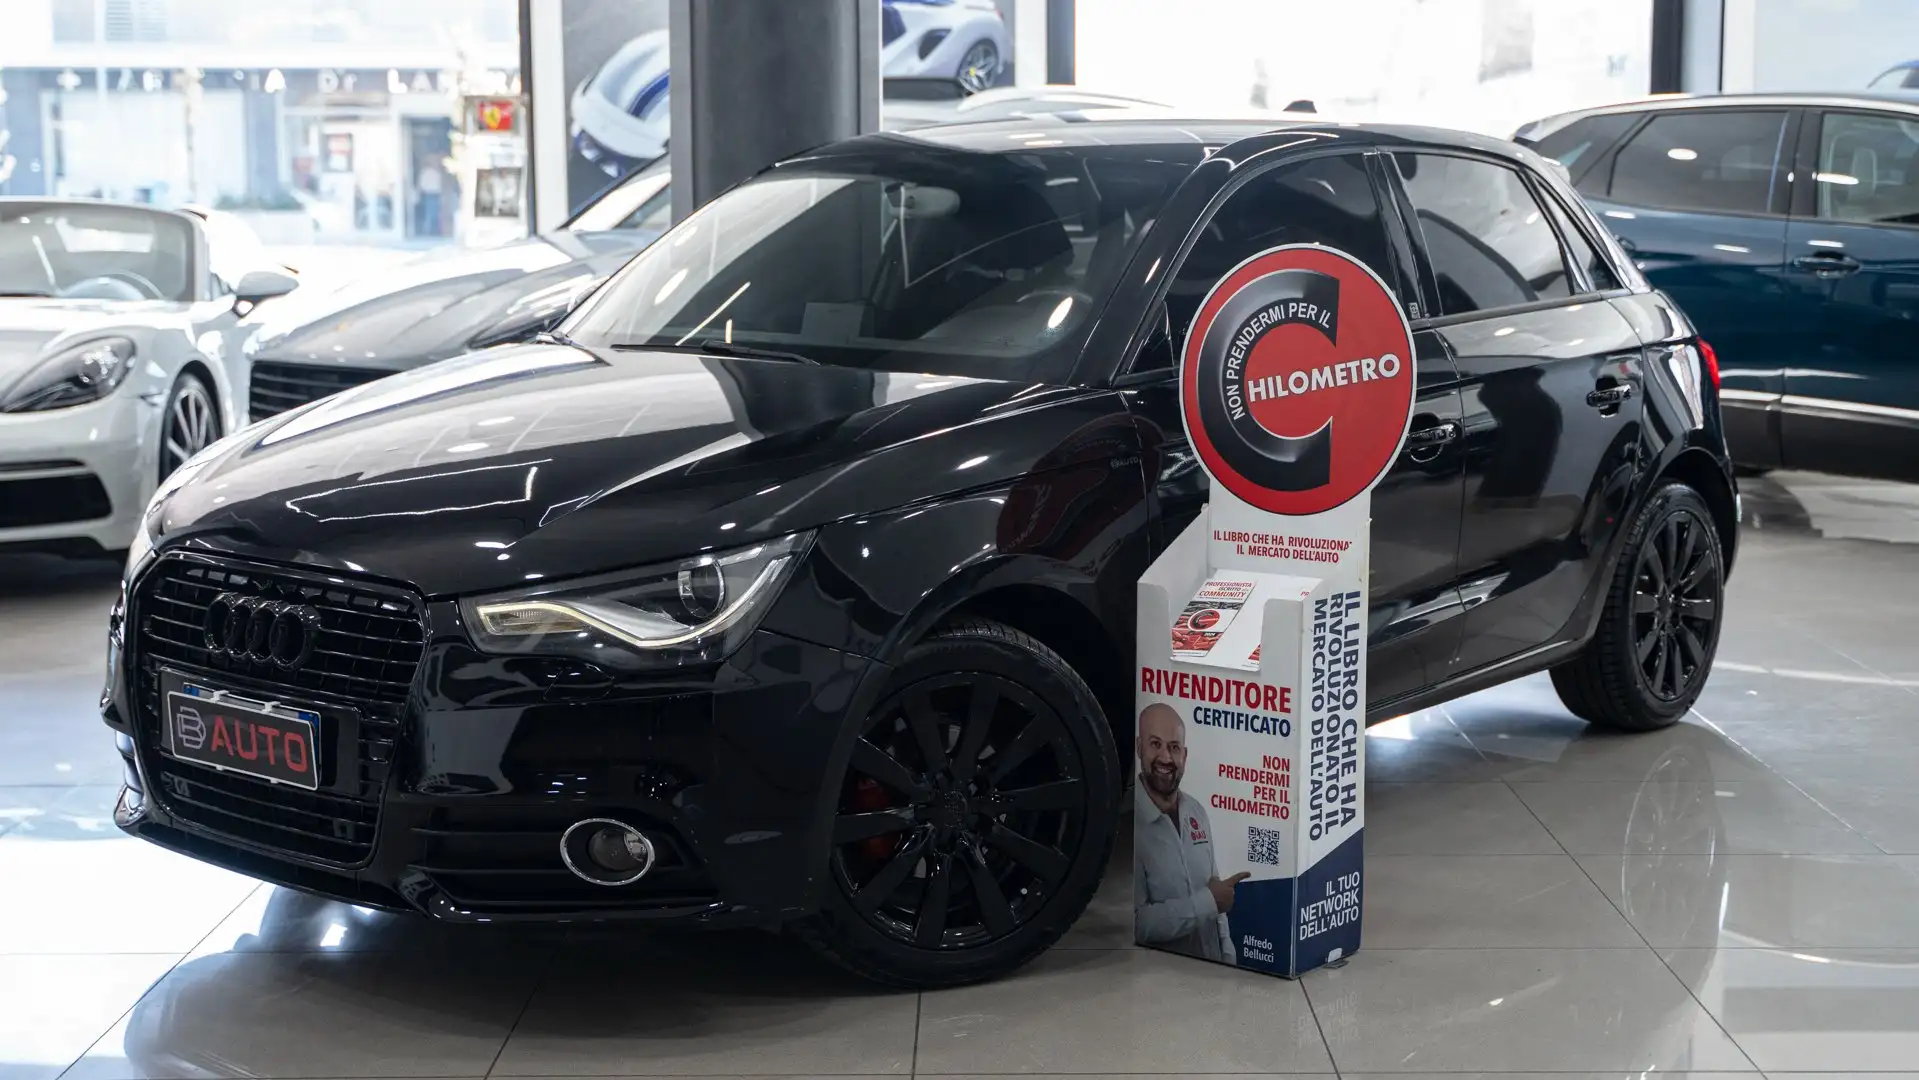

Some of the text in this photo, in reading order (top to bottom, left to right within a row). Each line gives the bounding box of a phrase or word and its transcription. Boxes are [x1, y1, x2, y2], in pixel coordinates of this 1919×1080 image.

[1226, 302, 1332, 420] NON PRENDERMI PER IL
[1214, 530, 1222, 540] IL
[1224, 530, 1250, 543] LIBRO
[1252, 533, 1270, 545] CHE
[1272, 535, 1284, 546] HA
[1236, 544, 1339, 563] IL MERCATO DELL'AUTO
[1141, 667, 1291, 714] RIVENDITORE
[1193, 706, 1291, 738] CERTIFICATO
[1310, 598, 1328, 841] MERCATO DELL'AUTO
[1325, 592, 1343, 835] RIVOLUZIONATO IL
[1340, 590, 1360, 828] IL LIBRO CHE HA
[211, 714, 308, 773] AUTO
[1218, 764, 1290, 788] PRENDERMI
[1262, 755, 1290, 772] NON
[1210, 794, 1290, 820] CHILOMETRO
[1253, 784, 1290, 804] PER IL
[1326, 871, 1360, 897] IL TUO
[1300, 889, 1358, 924] NETWORK
[1300, 906, 1359, 941] DELL'AUTO
[1243, 934, 1272, 950] Alfredo
[1243, 948, 1274, 964] Bellucci
